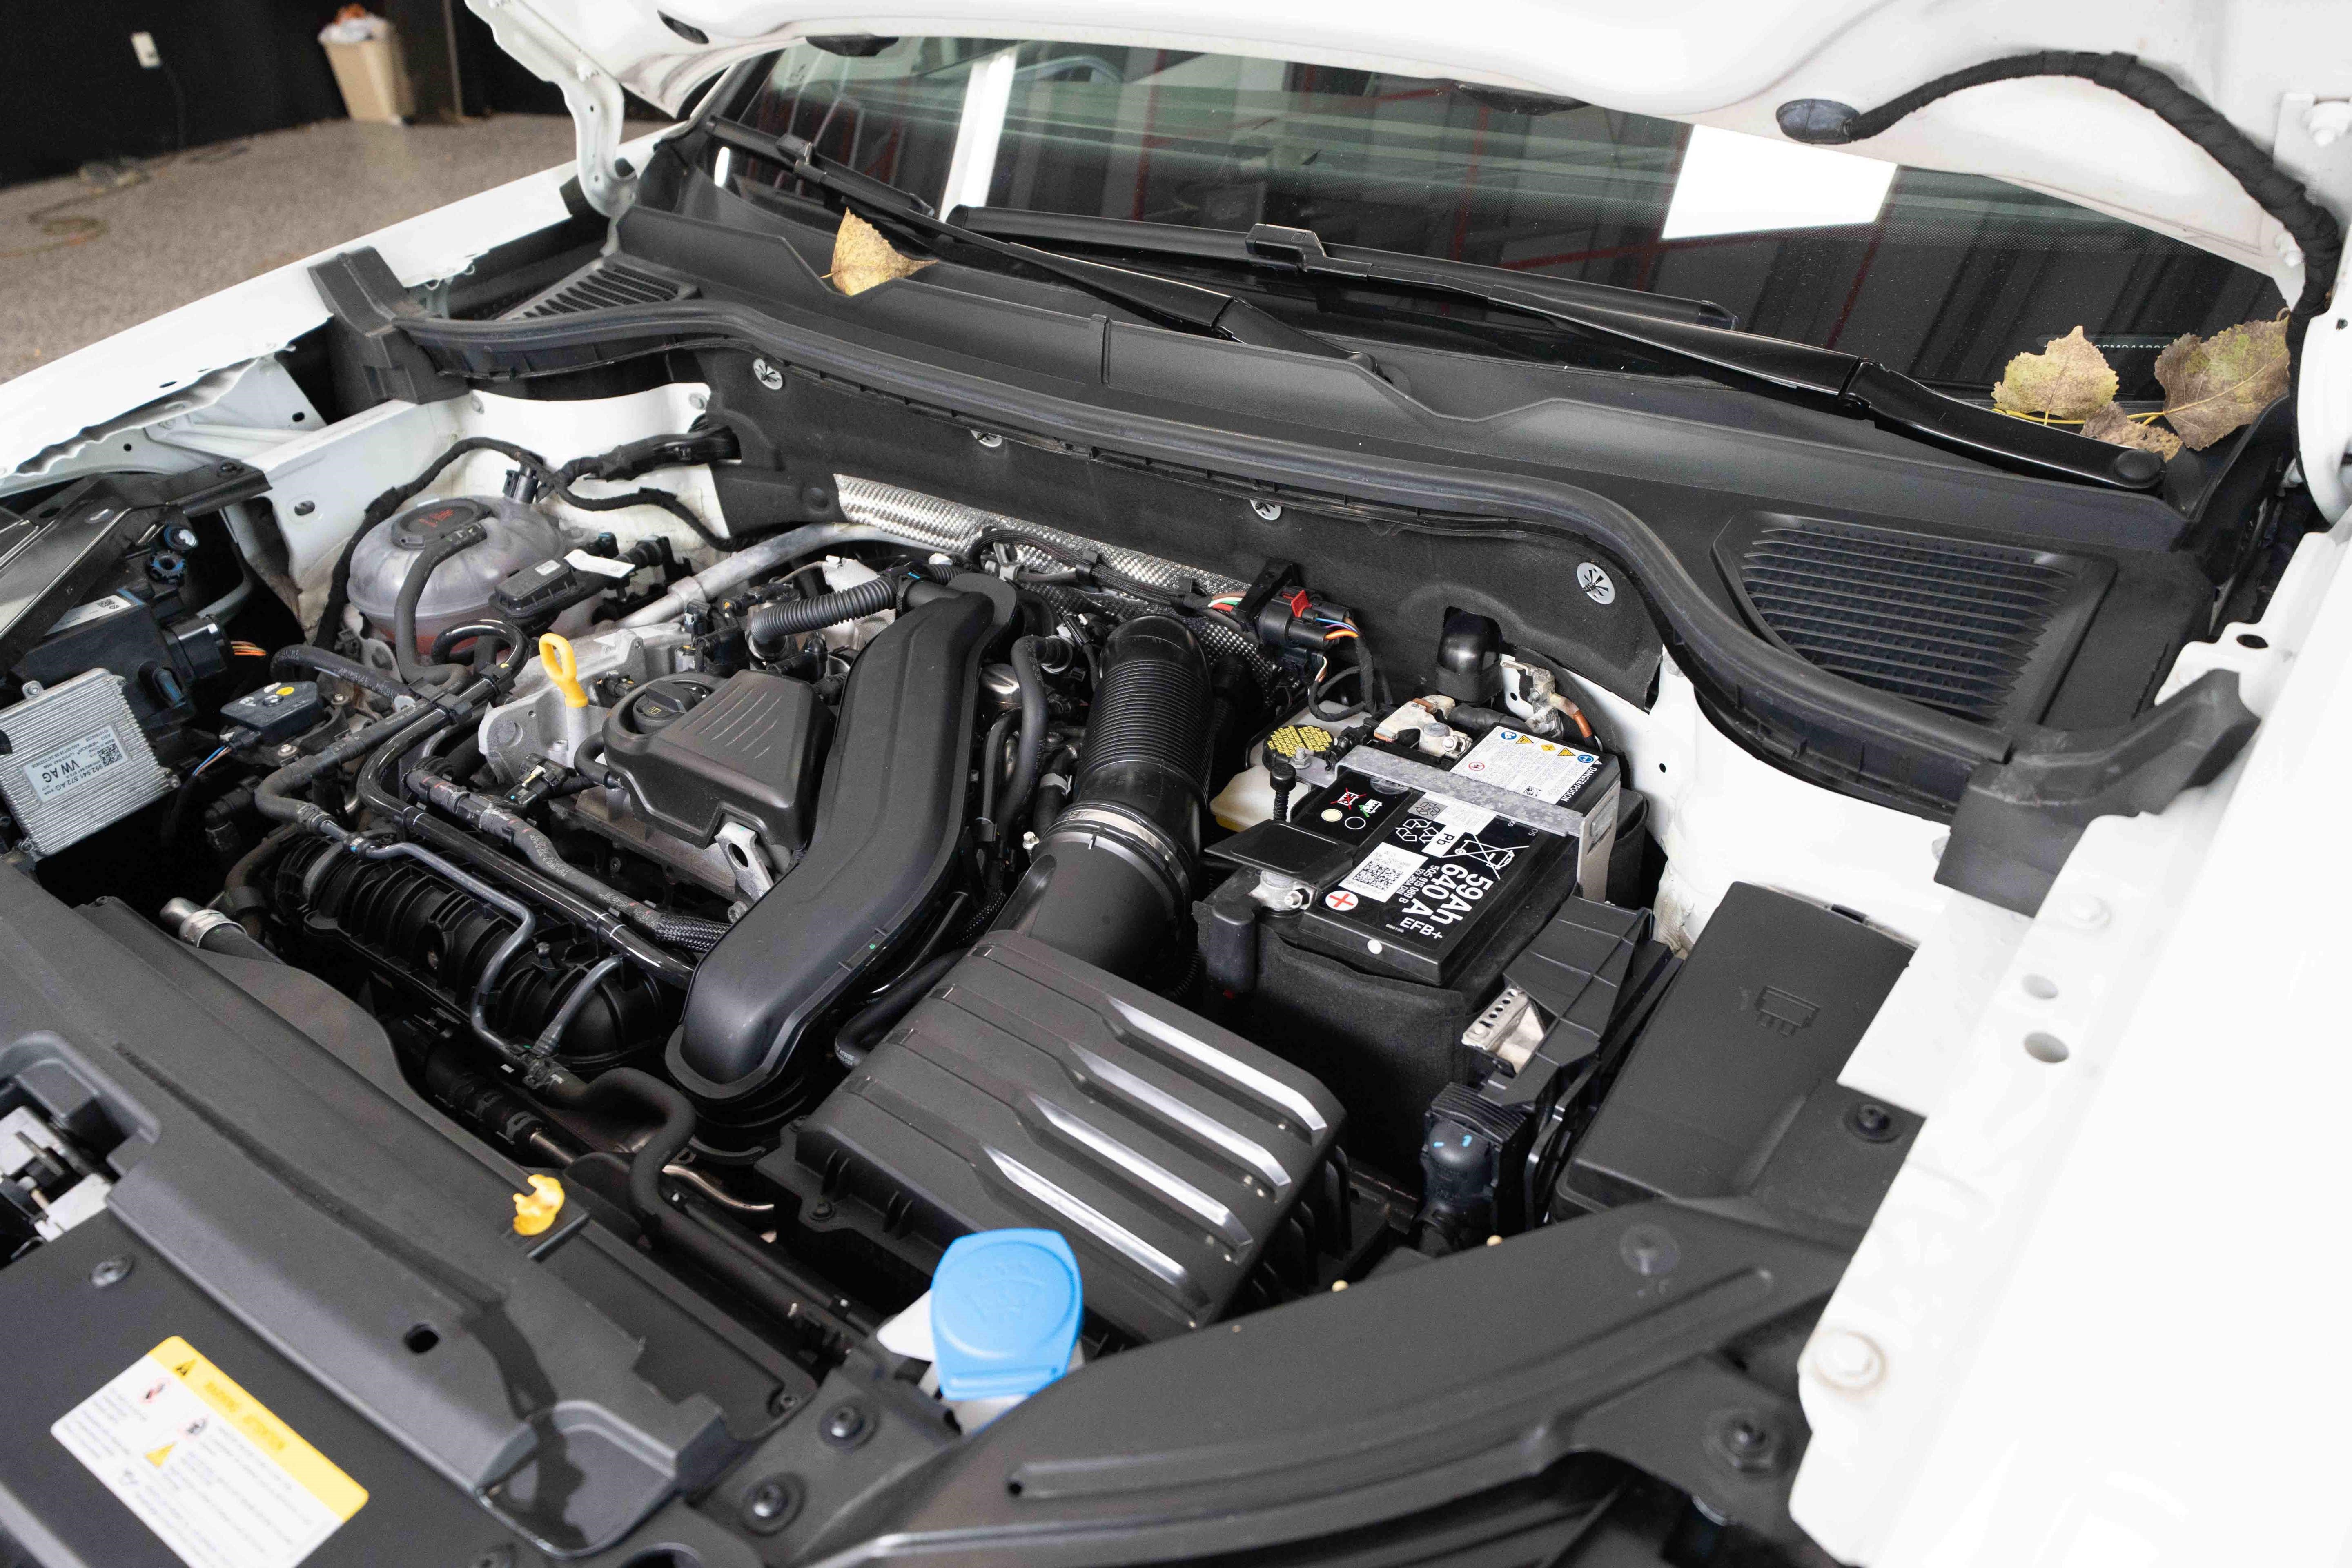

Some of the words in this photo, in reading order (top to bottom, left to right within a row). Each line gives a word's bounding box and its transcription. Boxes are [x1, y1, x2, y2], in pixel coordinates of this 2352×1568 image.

[60, 760, 80, 775] VW
[42, 768, 58, 783] AG
[1560, 766, 1597, 802] DANGER/POISON
[1436, 833, 1455, 845] Pb
[1415, 868, 1425, 877] 12V
[1414, 877, 1428, 887] 915
[1422, 864, 1468, 900] 640
[1396, 885, 1408, 895] DIN
[1403, 886, 1419, 898] 089
[1430, 873, 1494, 924] 59Ah
[1401, 898, 1434, 916] A
[1399, 917, 1443, 939] EFB+
